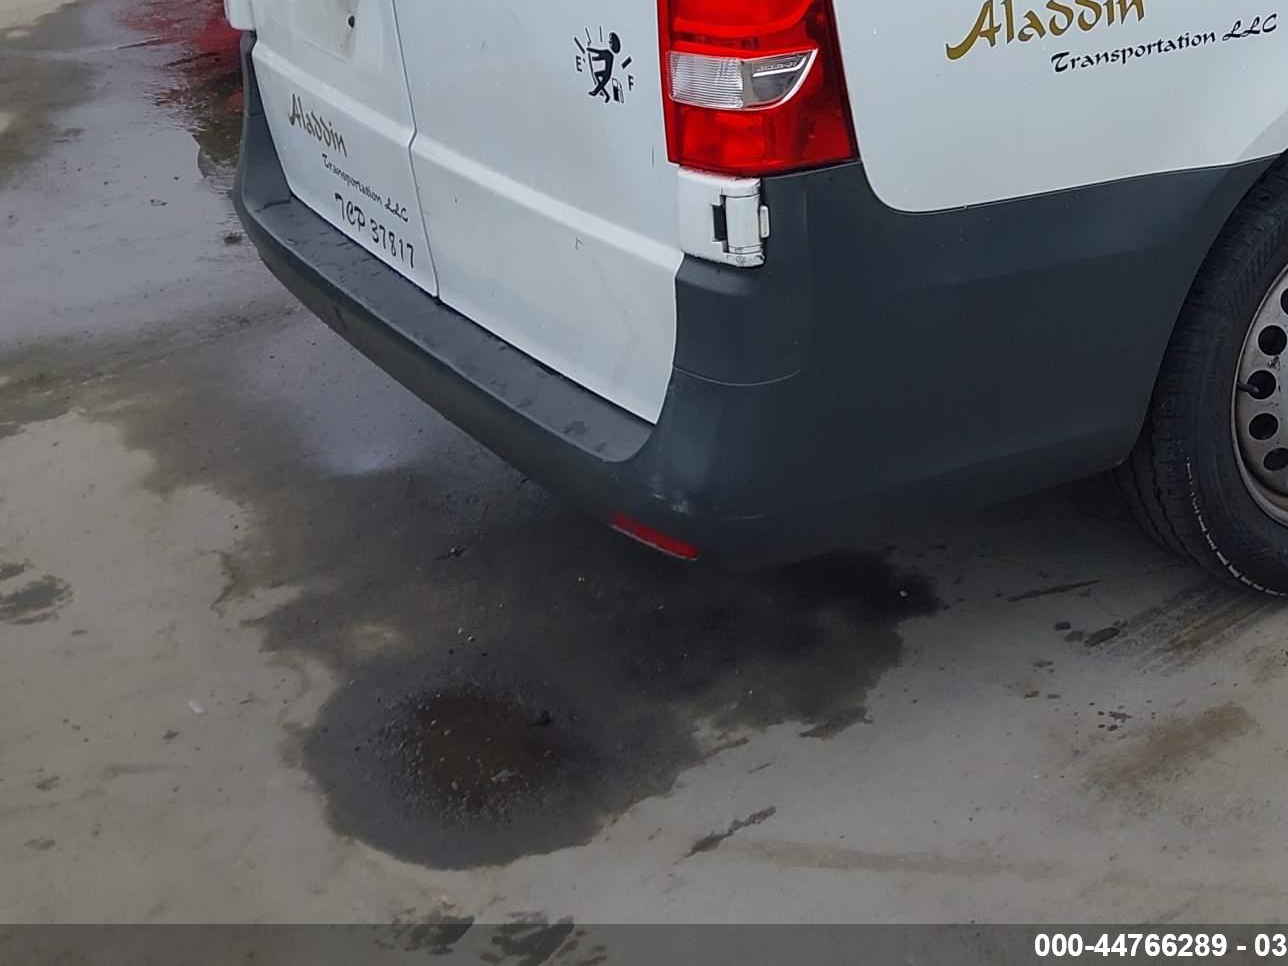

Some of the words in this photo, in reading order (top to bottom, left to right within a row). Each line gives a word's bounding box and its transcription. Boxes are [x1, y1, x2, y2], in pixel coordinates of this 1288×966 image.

[1051, 30, 1216, 73] Transportation
[1222, 14, 1278, 42] LLC
[288, 93, 347, 157] Aladdin
[322, 154, 382, 205] Transportation
[384, 197, 408, 222] LLC
[370, 219, 414, 269] 37817
